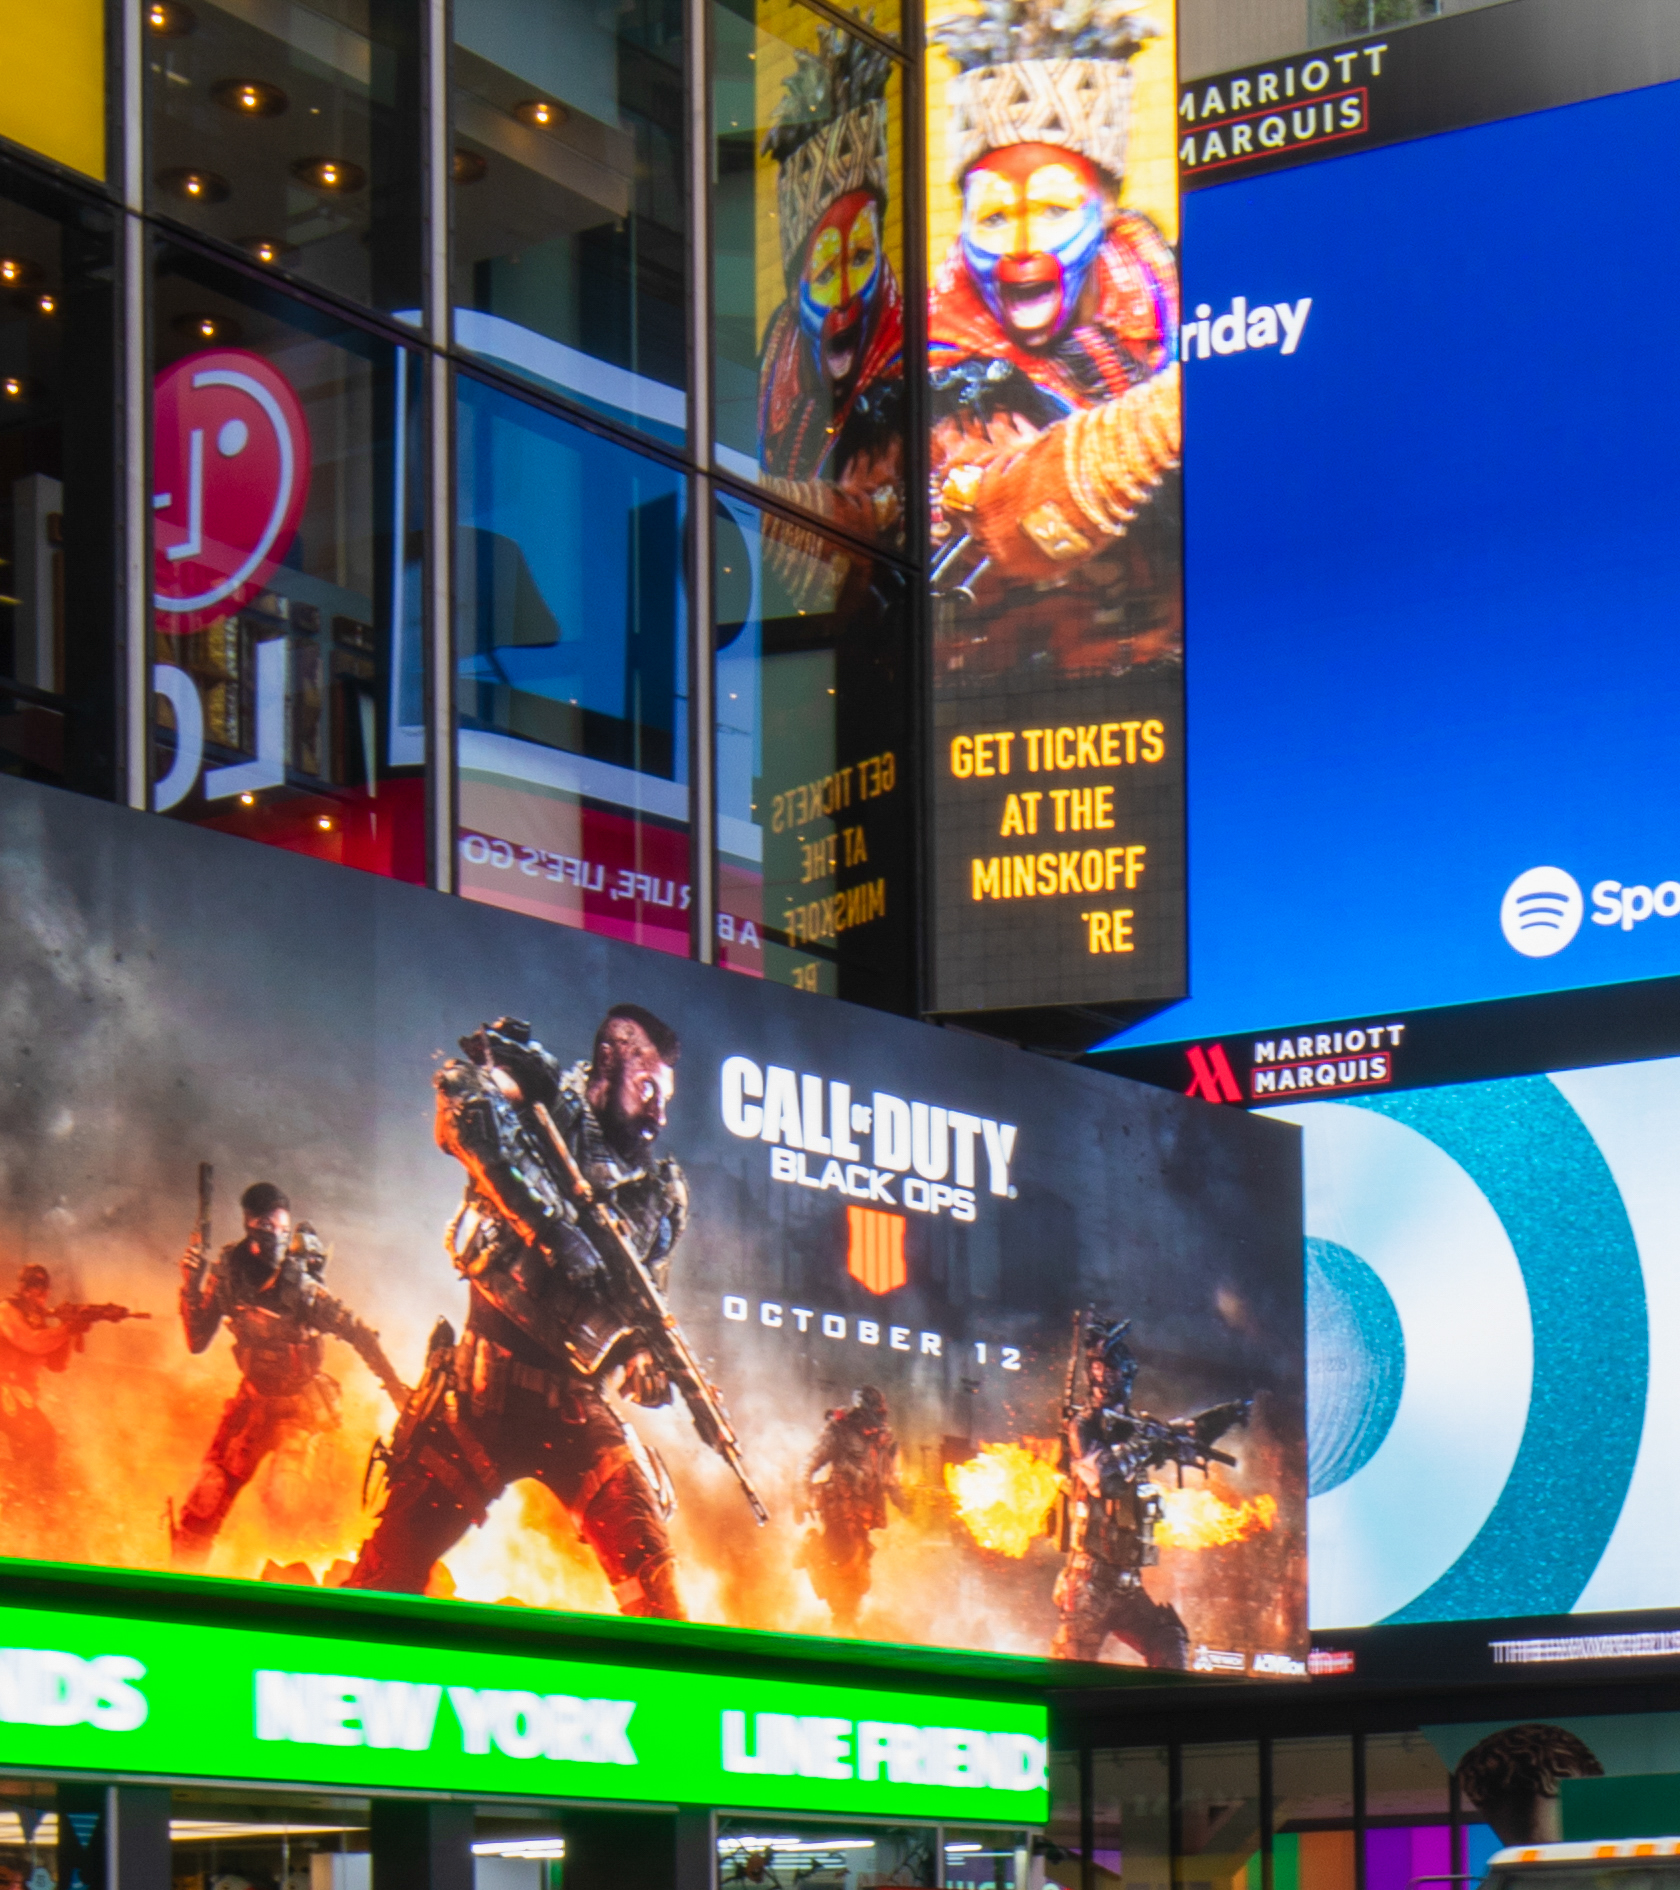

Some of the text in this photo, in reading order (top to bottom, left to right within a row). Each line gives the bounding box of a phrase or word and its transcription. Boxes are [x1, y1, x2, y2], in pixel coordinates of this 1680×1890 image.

[950, 719, 1166, 778] GET TICKETS
[1000, 786, 1116, 837] AT THE
[971, 845, 1147, 901] MINSKOFF
[1253, 1023, 1406, 1064] MARRIOTT
[1253, 1055, 1389, 1095] MARQUIS
[721, 1055, 1018, 1197] CALL OF DUTY
[770, 1147, 977, 1222] BLACK OPS
[722, 1295, 943, 1357] OCTOBER
[254, 1669, 443, 1752] NEW
[447, 1686, 639, 1766] YORK
[721, 1709, 852, 1781] LINE
[857, 1721, 1049, 1791] FRIEND
